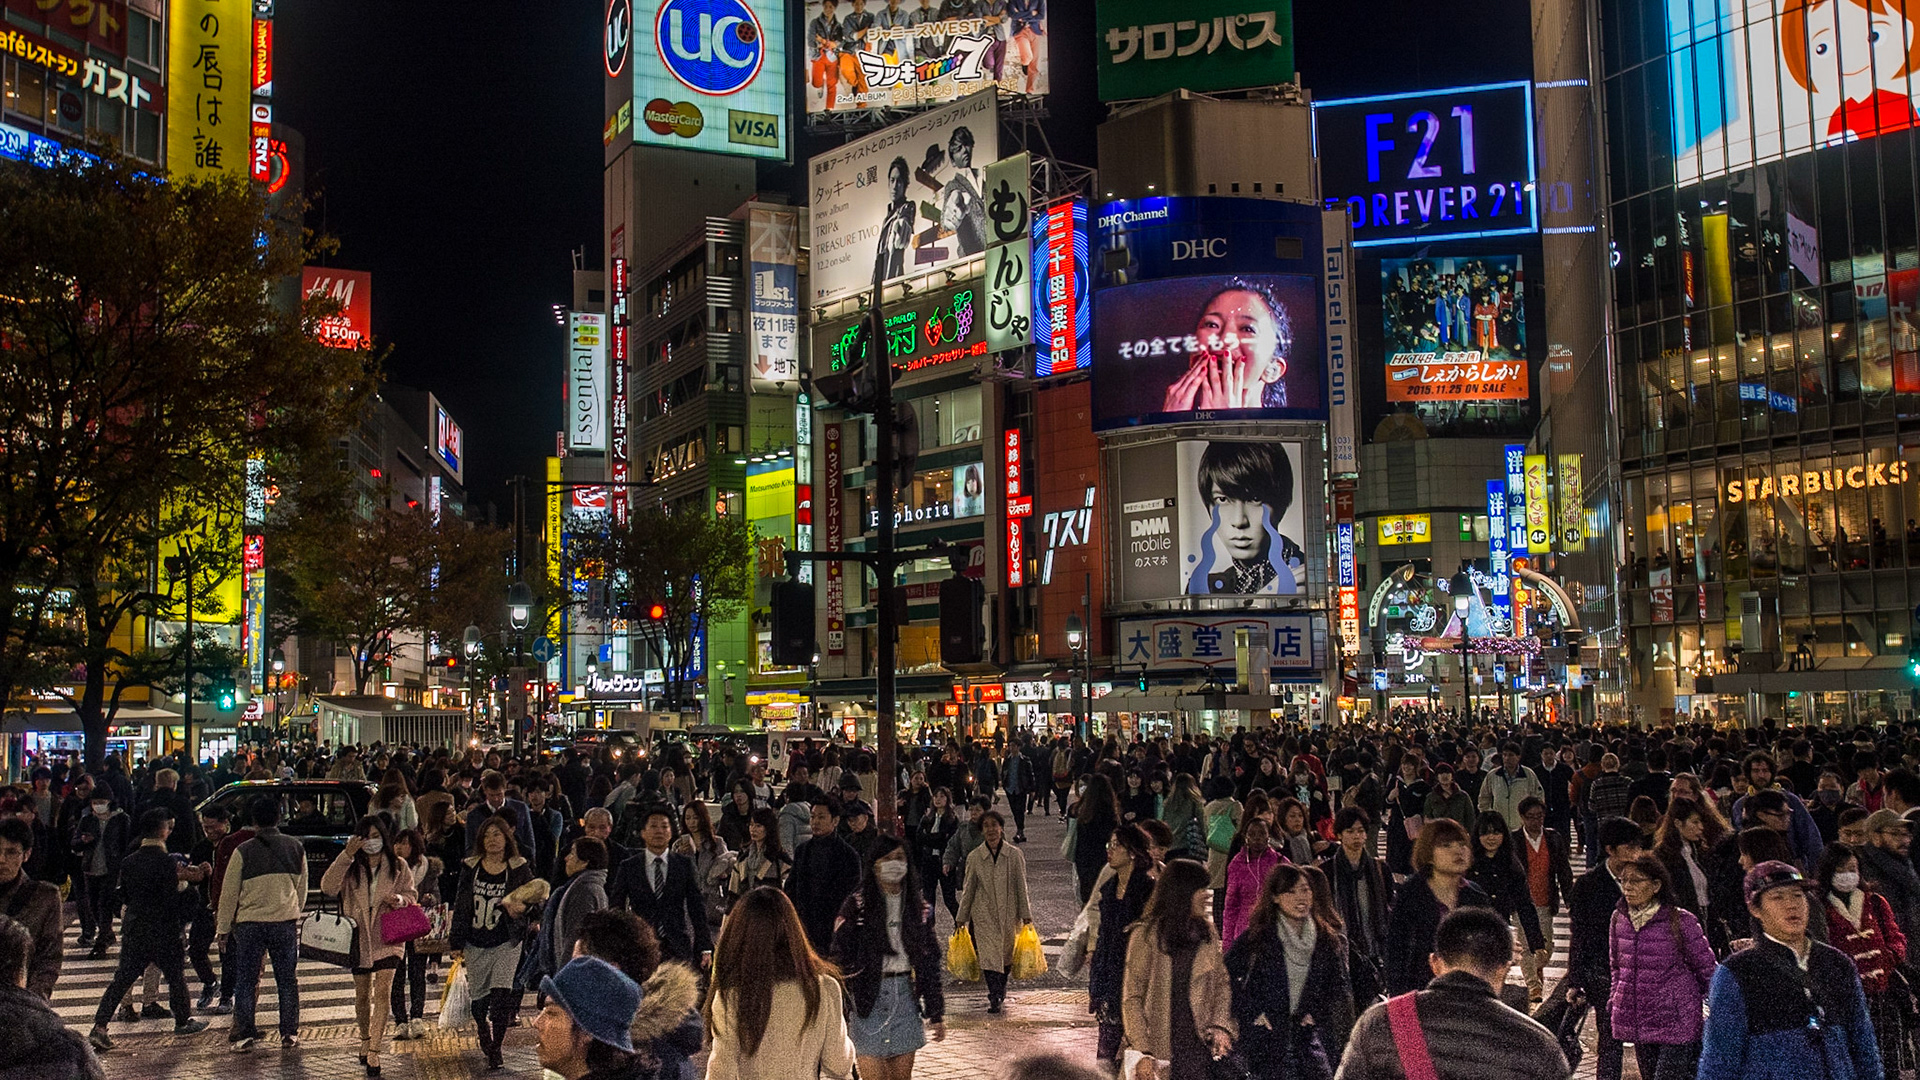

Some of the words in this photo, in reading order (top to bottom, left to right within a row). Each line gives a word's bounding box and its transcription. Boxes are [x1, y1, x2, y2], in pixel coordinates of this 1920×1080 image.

[36, 0, 120, 37] クト
[868, 20, 981, 41] ジャニーズWEST
[669, 8, 756, 69] UC
[1104, 10, 1283, 65] サロンパス
[82, 57, 151, 109] ガスト
[193, 0, 224, 170] の唇は誰
[836, 94, 853, 103] 2nd
[857, 92, 886, 102] ALBUM
[645, 109, 702, 127] MasterCard
[734, 119, 777, 139] VISA
[255, 137, 268, 174] ガスト
[1365, 104, 1476, 182] F21
[815, 164, 878, 205] タッキー&翼
[1488, 181, 1523, 217] 21
[815, 208, 830, 221] new
[830, 201, 850, 216] album
[1098, 214, 1122, 228] DHC
[1123, 206, 1168, 223] Channel
[815, 225, 840, 238] TRIP&
[815, 232, 857, 257] TREASURE
[858, 224, 880, 243] TWO
[989, 179, 1030, 341] もんじゃ
[1171, 237, 1227, 261] DHC
[306, 276, 356, 310] HM
[1050, 211, 1069, 364] 三千里薬品
[1326, 239, 1347, 327] Taisei
[755, 299, 795, 308] ブックファースト
[324, 326, 361, 340] 150m
[753, 317, 796, 333] 夜11時
[761, 335, 788, 349] まで
[1391, 352, 1435, 364] HKT48
[774, 358, 797, 375] 地下
[1330, 334, 1346, 406] neon
[1420, 364, 1521, 383] しぇからしか!
[573, 347, 593, 446] Essential
[1407, 384, 1462, 396] 2015.11.25
[1465, 384, 1479, 394] ON
[1482, 383, 1507, 394] SALE
[1195, 411, 1216, 421] DHC
[1007, 432, 1019, 494] お好み焼
[750, 483, 780, 493] Matsumoto
[781, 478, 796, 490] KiYo
[1727, 460, 1909, 504] STARBUCKS
[871, 502, 951, 529] Ephoria
[1507, 450, 1527, 549] 洋服の青山
[1130, 516, 1171, 538] DMM
[1490, 492, 1508, 595] 洋服の青山
[1531, 532, 1546, 543] 4F
[759, 534, 788, 579] 薬
[1009, 521, 1021, 585] もんじゃ焼
[1130, 535, 1172, 554] mobile
[1134, 555, 1168, 568] のスマホ
[1128, 626, 1302, 660] 大盛堂店
[472, 894, 503, 931] 96
